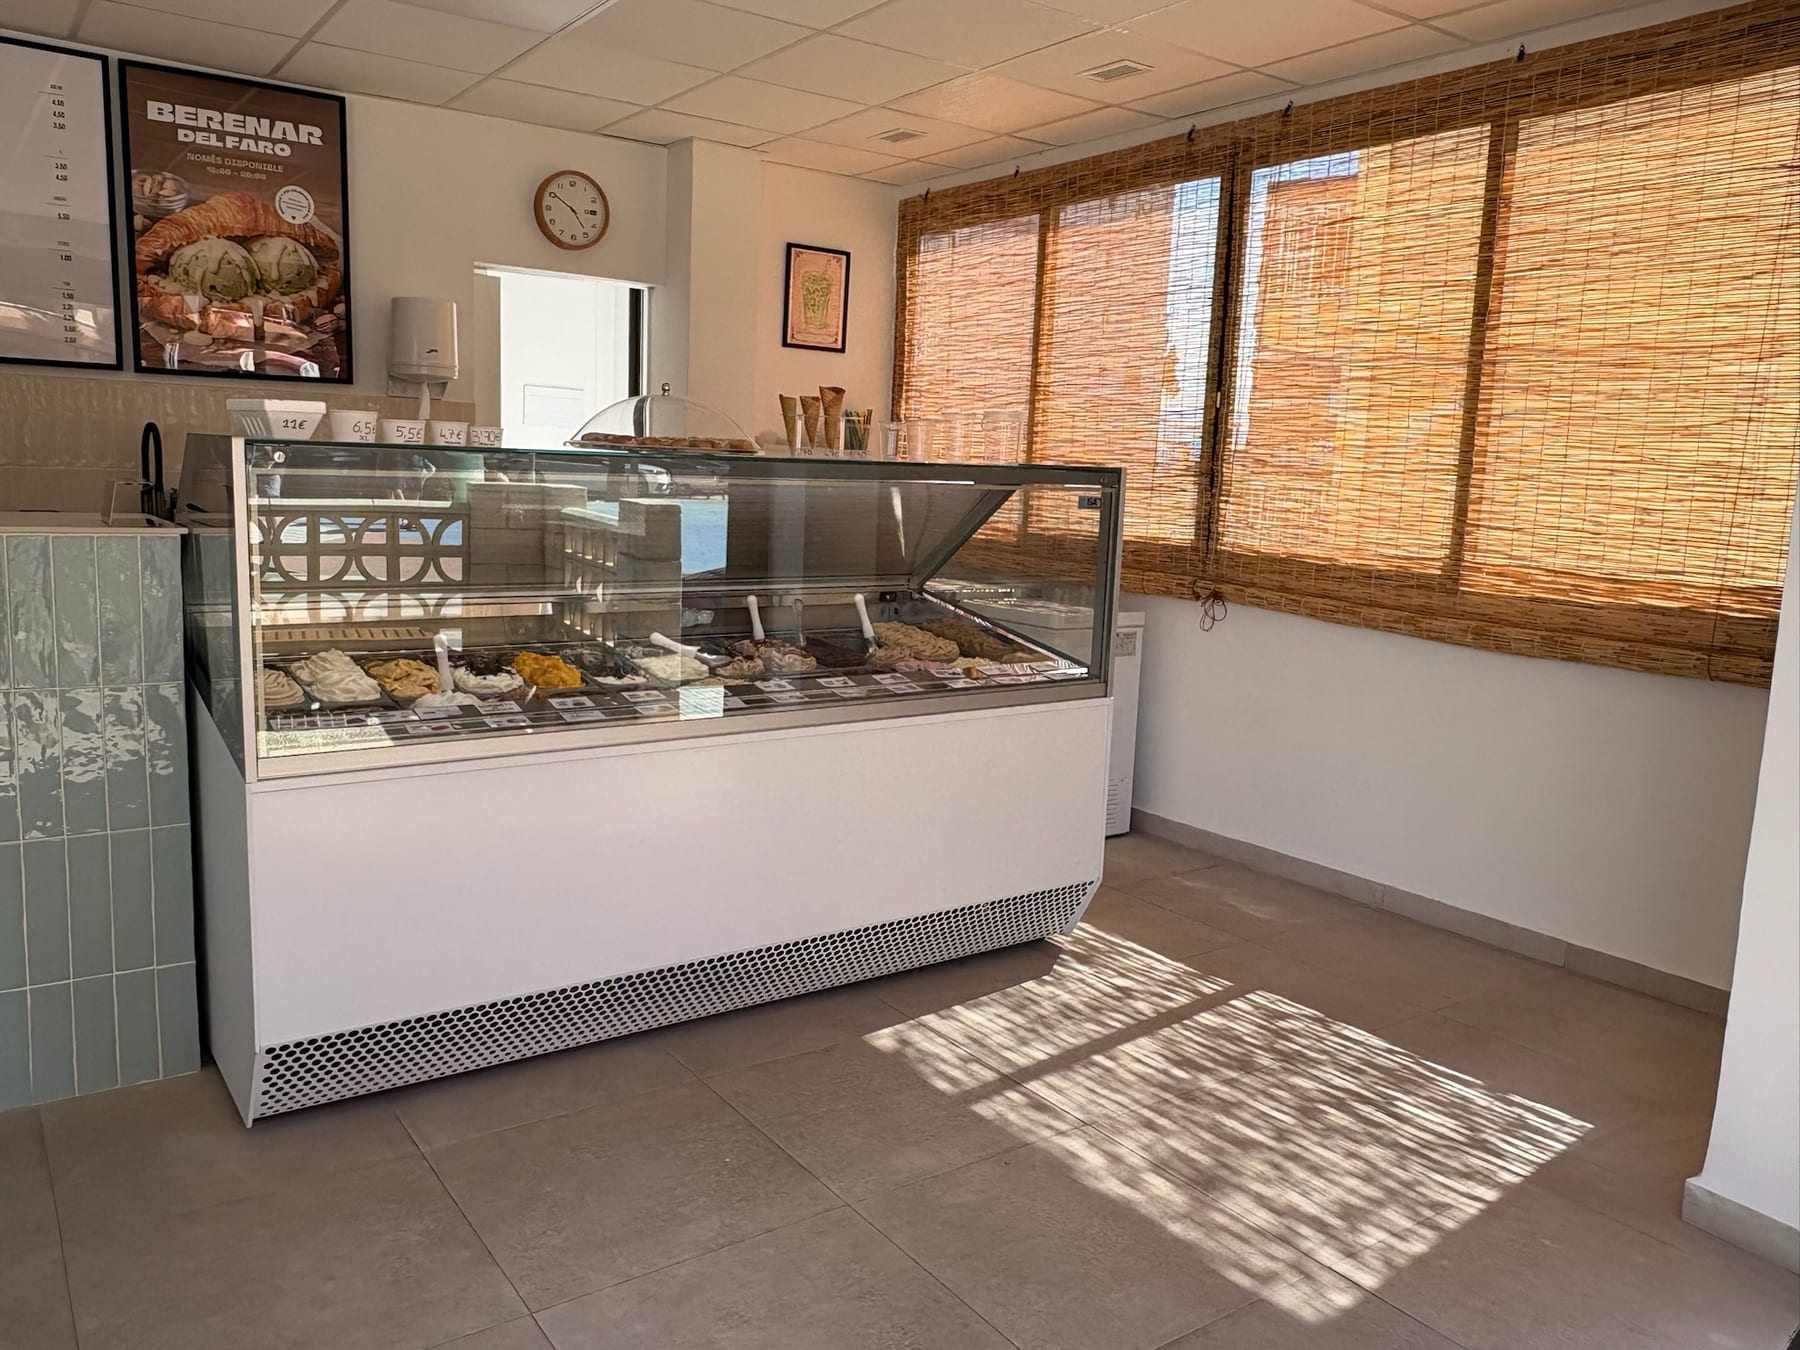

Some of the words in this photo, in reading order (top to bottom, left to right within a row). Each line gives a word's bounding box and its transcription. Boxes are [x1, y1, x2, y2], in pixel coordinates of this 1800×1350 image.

[147, 100, 324, 146] BERENAR
[177, 128, 224, 147] DEL
[225, 135, 292, 157] FARO
[224, 158, 285, 173] DISPONIBLE
[282, 418, 308, 430] 11€
[396, 425, 424, 440] 5,5€
